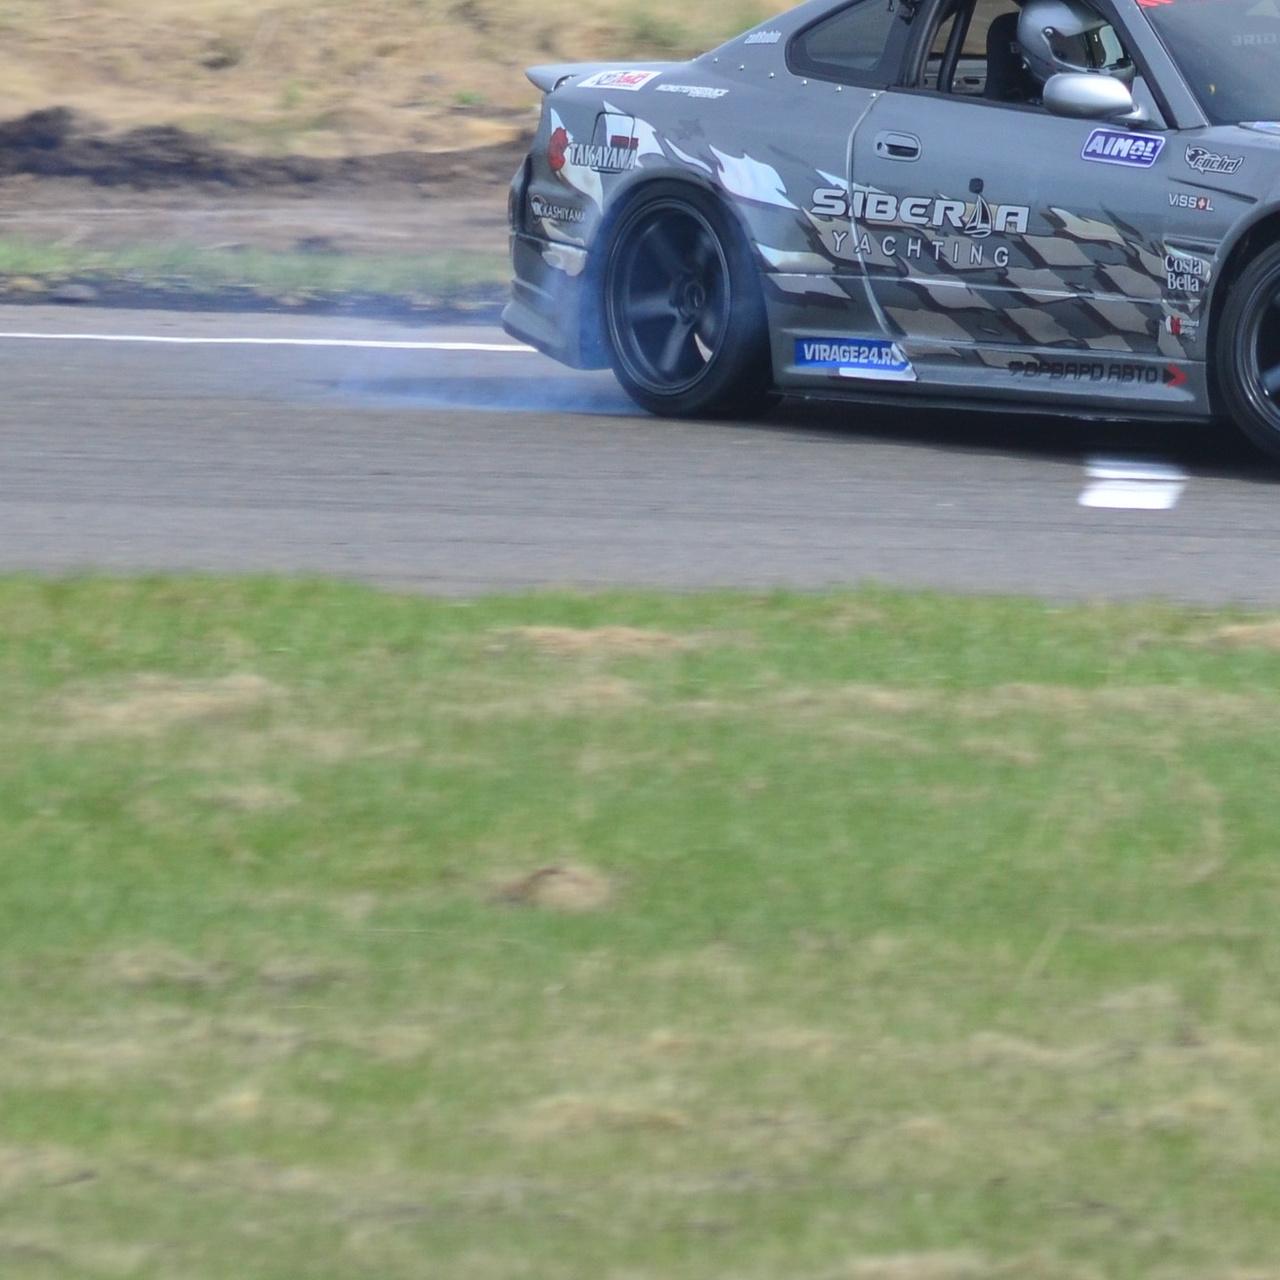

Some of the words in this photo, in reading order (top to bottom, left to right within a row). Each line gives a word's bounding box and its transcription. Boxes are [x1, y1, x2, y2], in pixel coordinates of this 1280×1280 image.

[569, 143, 638, 170] TAKAYAMA
[1086, 135, 1157, 161] AIMOL
[832, 231, 1010, 268] YACHTING
[1164, 254, 1203, 275] Costa
[1167, 272, 1200, 292] Bella
